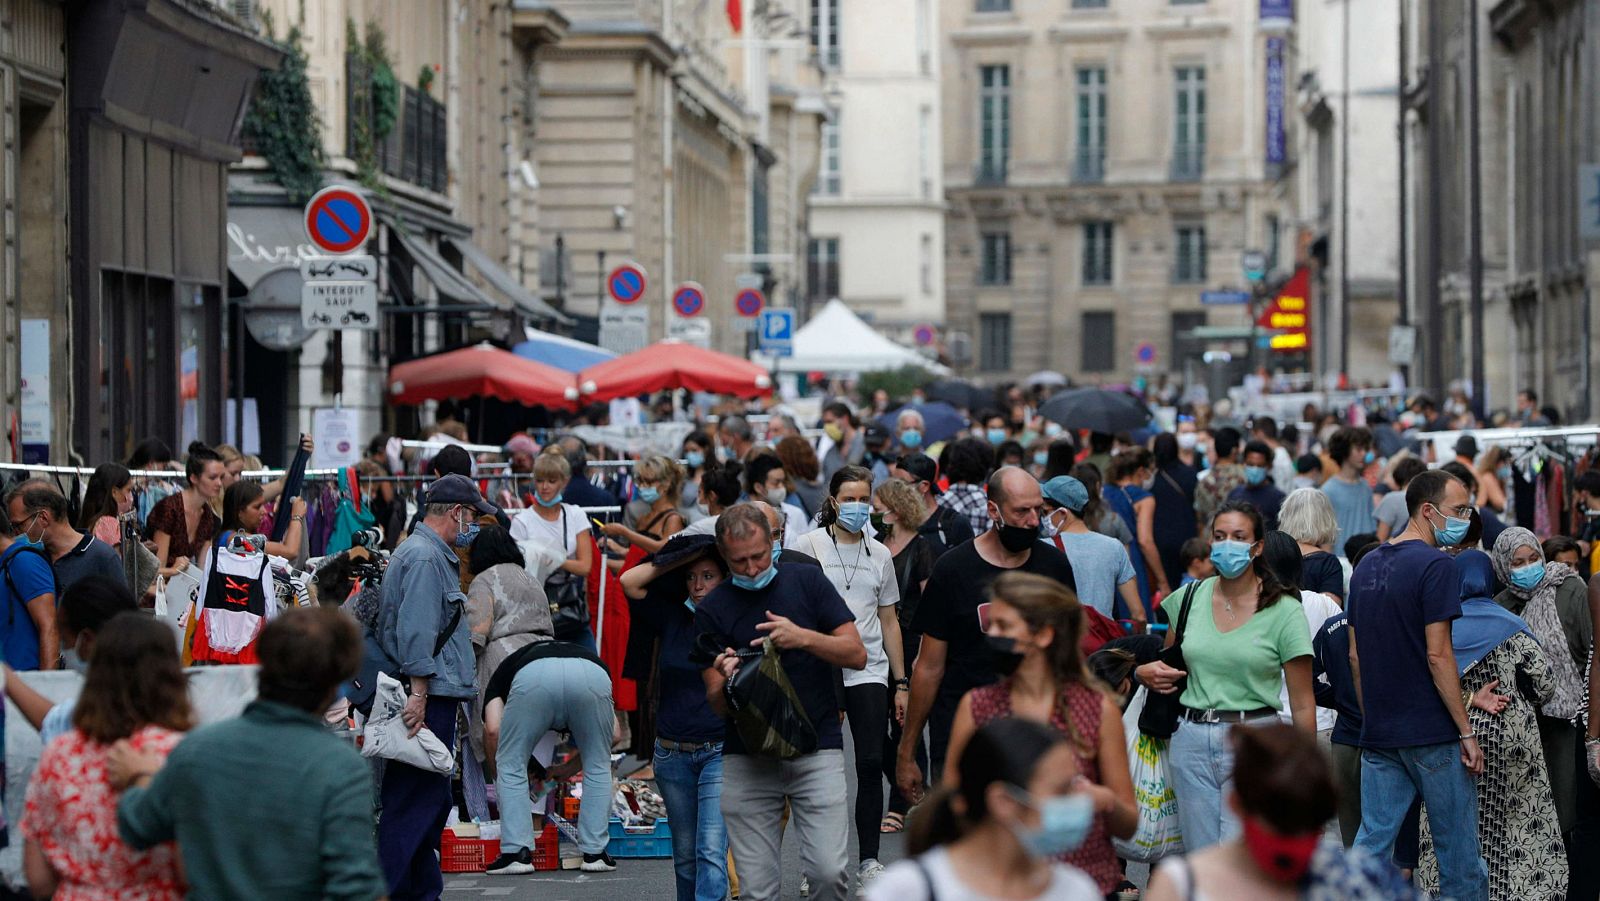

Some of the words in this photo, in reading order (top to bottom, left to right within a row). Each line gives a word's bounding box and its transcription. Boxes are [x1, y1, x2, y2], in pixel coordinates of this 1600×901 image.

[313, 286, 365, 296] INTERDIT
[325, 298, 354, 306] SAUF
[769, 315, 787, 336] P
